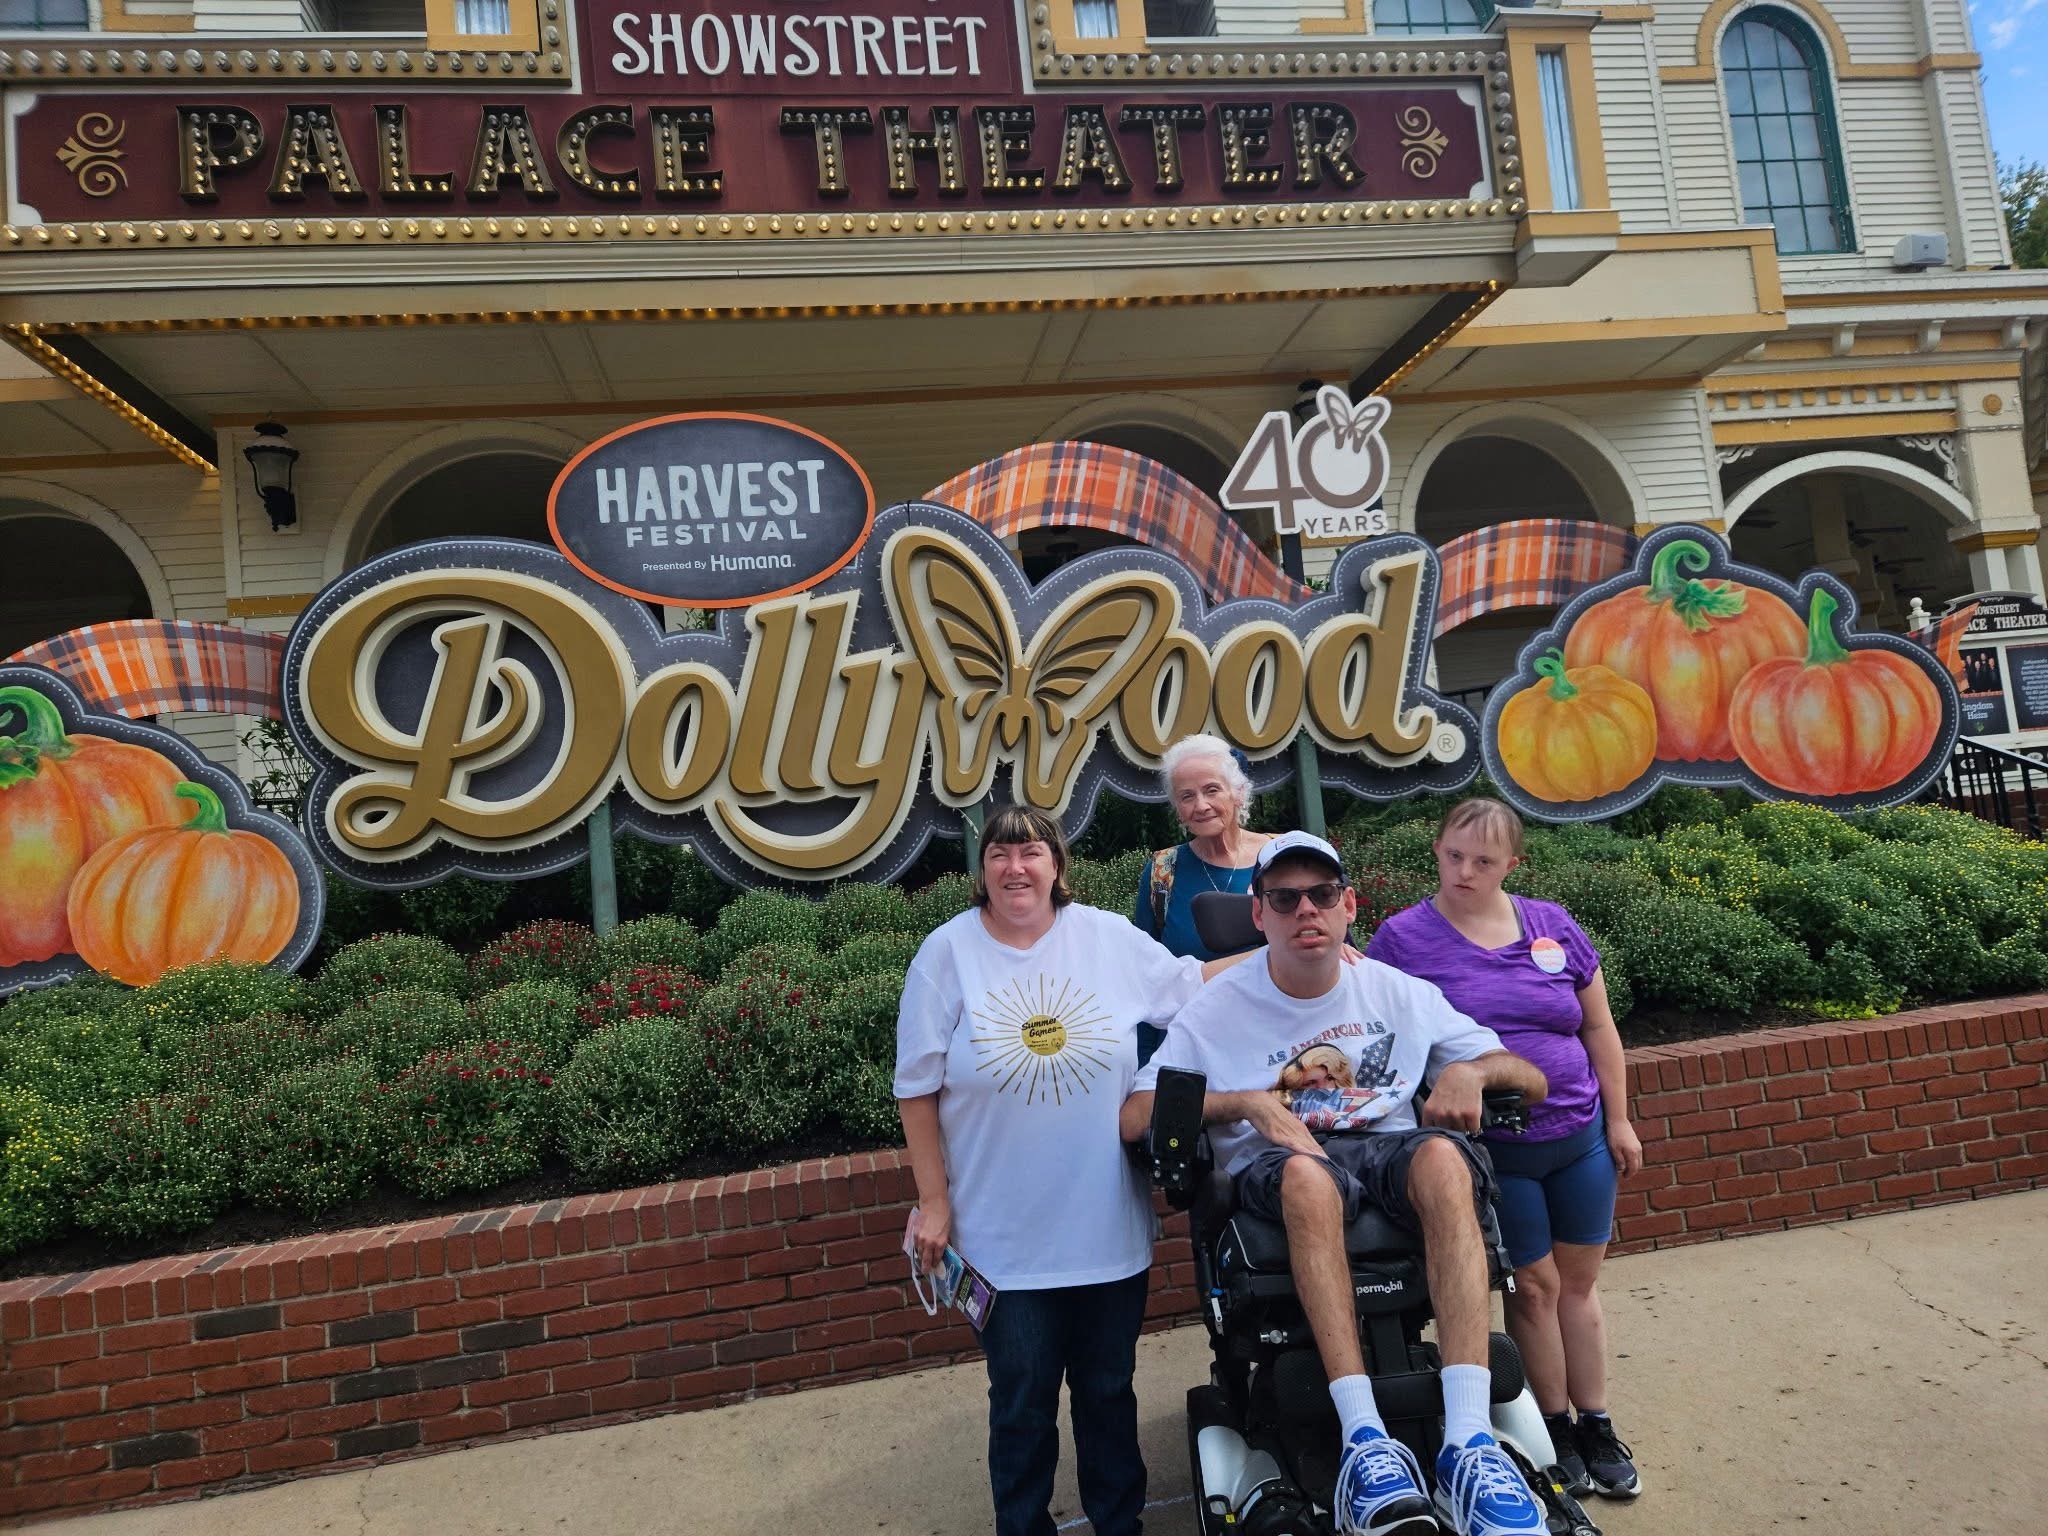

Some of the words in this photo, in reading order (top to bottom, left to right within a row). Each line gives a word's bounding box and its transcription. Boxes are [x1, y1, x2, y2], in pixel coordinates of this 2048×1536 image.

[612, 12, 986, 76] SHOWSTREET
[177, 104, 725, 201] PALACE
[778, 101, 1369, 195] THEATER
[1225, 418, 1385, 529] 40
[595, 459, 825, 524] HARVEST
[626, 519, 807, 548] FESTIVAL
[1304, 514, 1385, 534] YEARS
[642, 560, 692, 572] Presented
[695, 559, 707, 570] By
[1973, 603, 2020, 616] OWSTREET
[1966, 618, 1988, 631] ACE
[1994, 613, 2047, 630] THEATER
[1021, 1015, 1060, 1031] Summer
[1029, 1026, 1062, 1038] Games
[1267, 1050, 1287, 1067] AS
[1290, 1022, 1364, 1057] AMERICAN
[1366, 1021, 1387, 1035] AS
[1355, 1280, 1404, 1297] permobil
